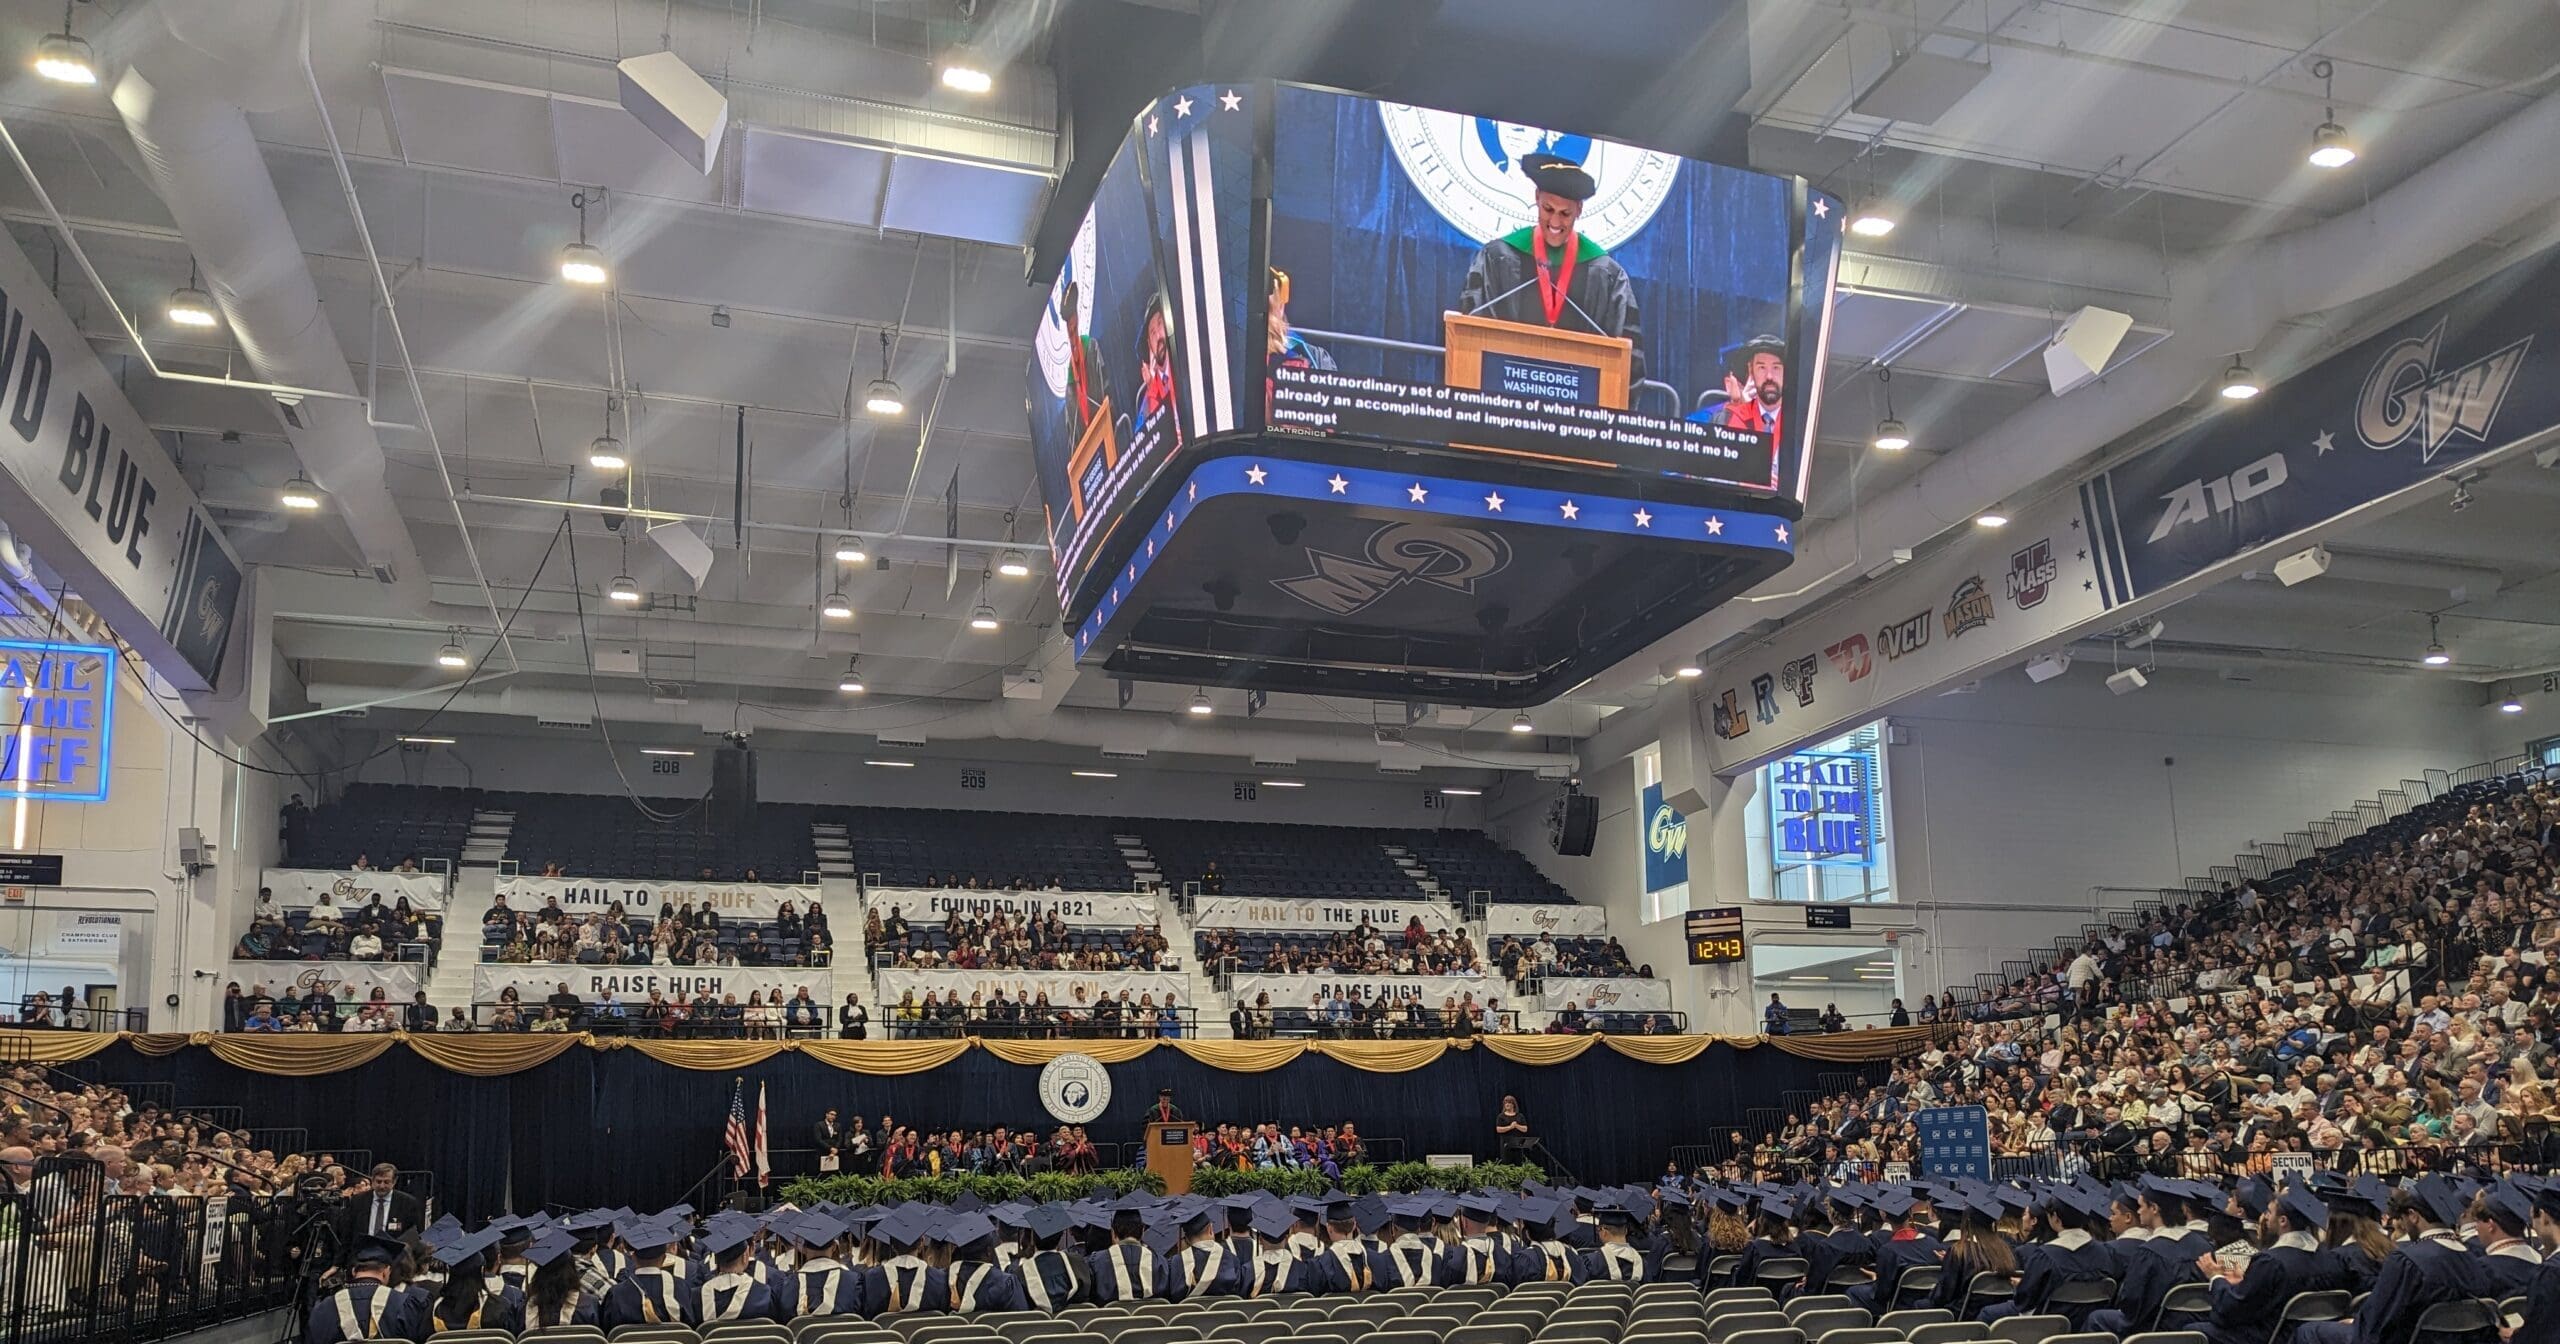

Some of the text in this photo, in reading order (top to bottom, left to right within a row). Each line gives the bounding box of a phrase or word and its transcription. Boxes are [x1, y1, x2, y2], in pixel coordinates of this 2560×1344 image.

[1504, 366, 1579, 388] THE GEORGE
[1503, 379, 1579, 401] WASHINGTON
[1276, 368, 1758, 445] that extraordinary set of reminders of what really matters in life. You are
[1275, 408, 1338, 426] amongst
[1275, 388, 1738, 459] already an accomplished and impressive group of leaders so let me be
[1266, 426, 1327, 438] DAKTRONICS
[59, 390, 157, 570] BLUE
[2146, 451, 2289, 545] A10
[1942, 594, 1995, 639] MASON
[1877, 608, 1933, 662] VCU
[17, 695, 93, 730] THE
[653, 760, 680, 774] 208
[1781, 761, 1860, 787] HAIL
[961, 776, 986, 788] 209
[1234, 788, 1256, 801] 210
[1424, 796, 1445, 809] 211
[1780, 788, 1863, 815] TO THE
[1784, 817, 1864, 855] BLUE
[332, 877, 373, 903] GW
[564, 887, 756, 908] HAIL TO THE BUFF
[930, 897, 1093, 916] FOUNDED IN 1821
[1249, 906, 1287, 921] HAIL
[1293, 908, 1315, 922] TO
[1323, 907, 1353, 923] THE
[1532, 910, 1560, 930] GW
[1697, 939, 1741, 959] 12:43
[590, 975, 723, 995] RAISE HIGH
[1035, 980, 1059, 997] AT
[1380, 985, 1423, 1000] HIGH
[1887, 1164, 1909, 1174] SECTION
[2272, 1157, 2312, 1168] SECTION
[206, 1221, 223, 1256] 103
